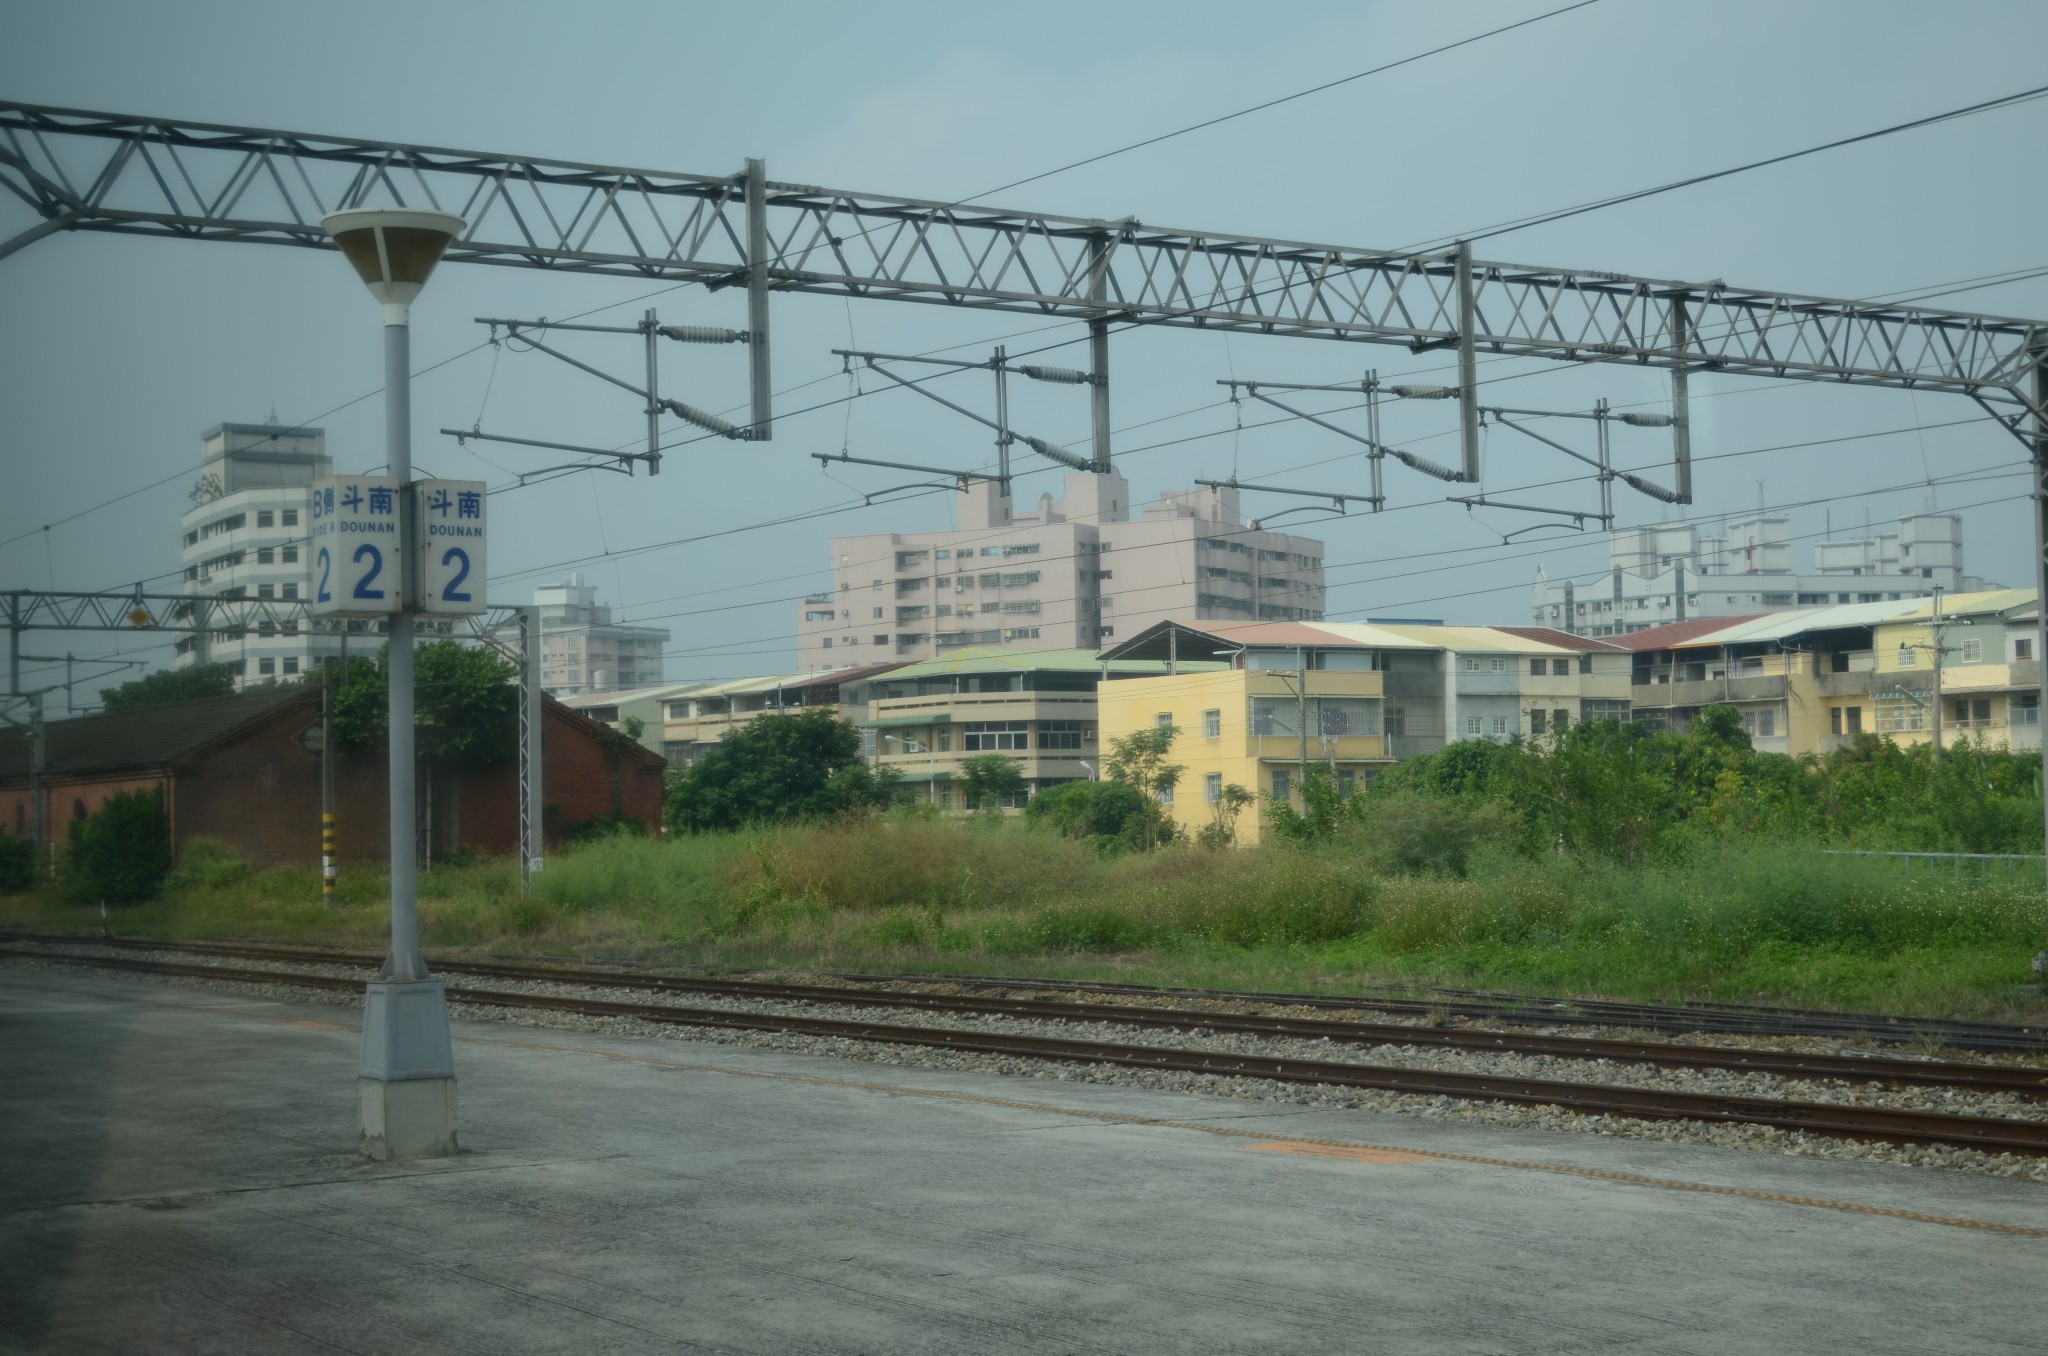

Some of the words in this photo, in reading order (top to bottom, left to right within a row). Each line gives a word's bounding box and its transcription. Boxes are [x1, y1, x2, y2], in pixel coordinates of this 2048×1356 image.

[341, 485, 394, 515] 斗南
[430, 489, 482, 519] 斗南
[340, 521, 395, 533] DOUNAN
[430, 524, 482, 537] DOUNAN
[317, 546, 332, 603] 2
[353, 543, 385, 600] 2
[441, 547, 472, 602] 2
